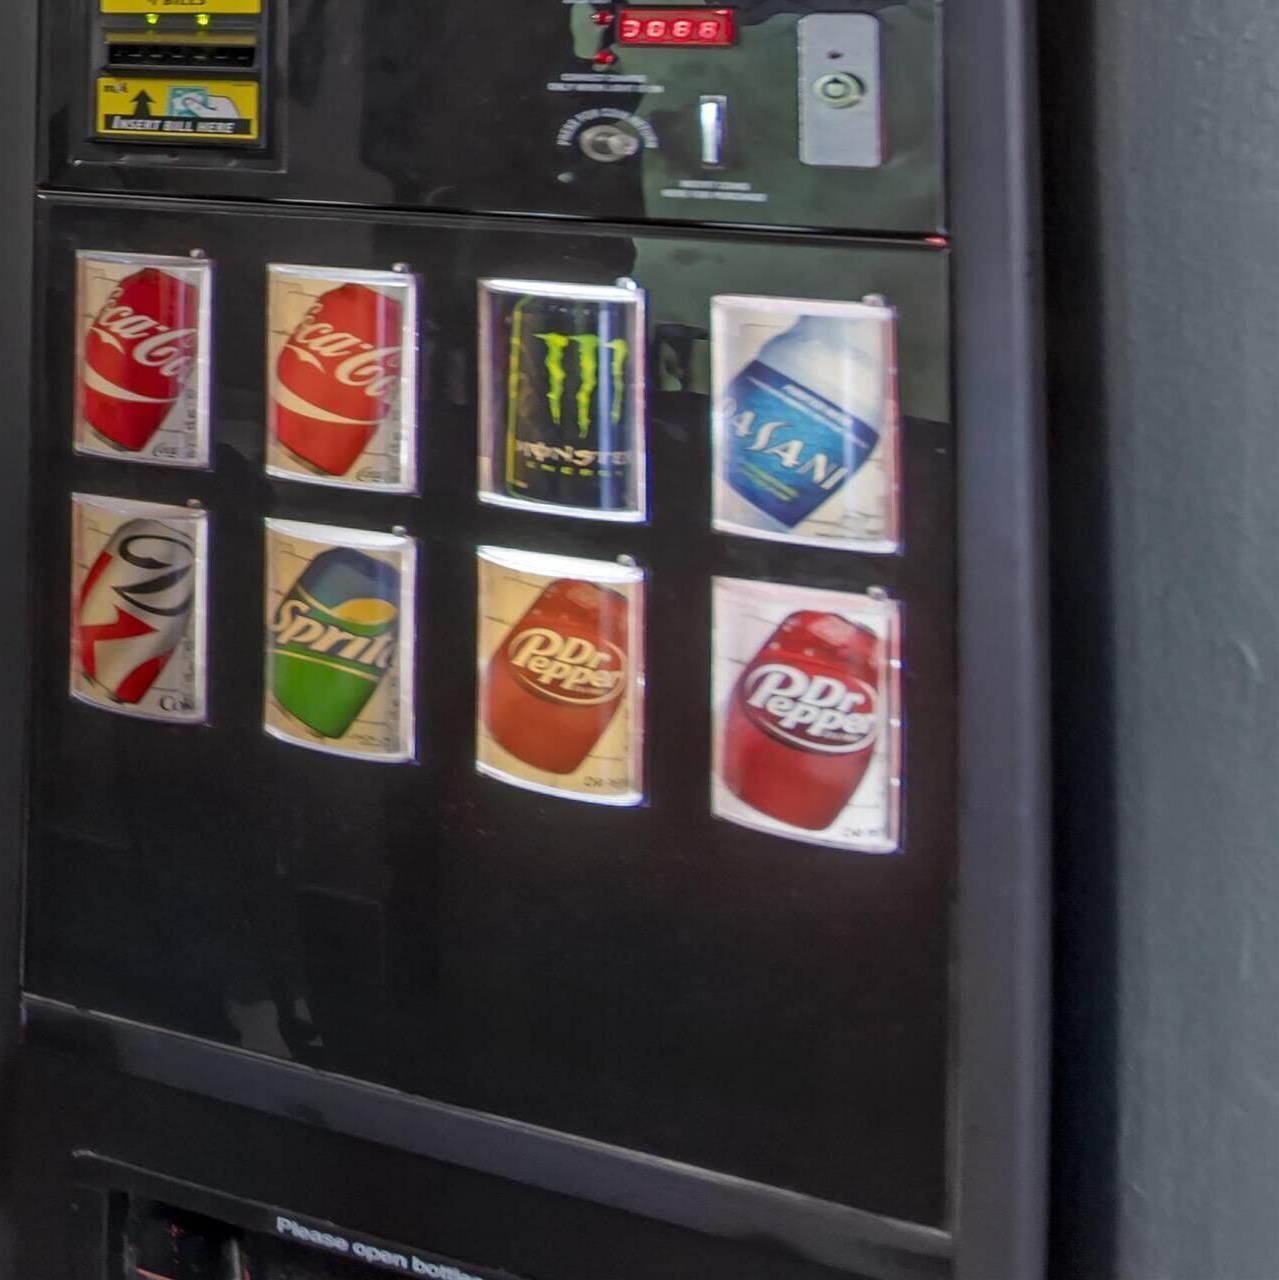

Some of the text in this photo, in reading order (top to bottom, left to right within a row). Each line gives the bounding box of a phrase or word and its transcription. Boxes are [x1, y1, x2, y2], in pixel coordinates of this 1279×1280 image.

[560, 636, 612, 670] Dr
[800, 675, 867, 712] Dr
[276, 1216, 350, 1252] Please
[352, 1242, 408, 1269] open
